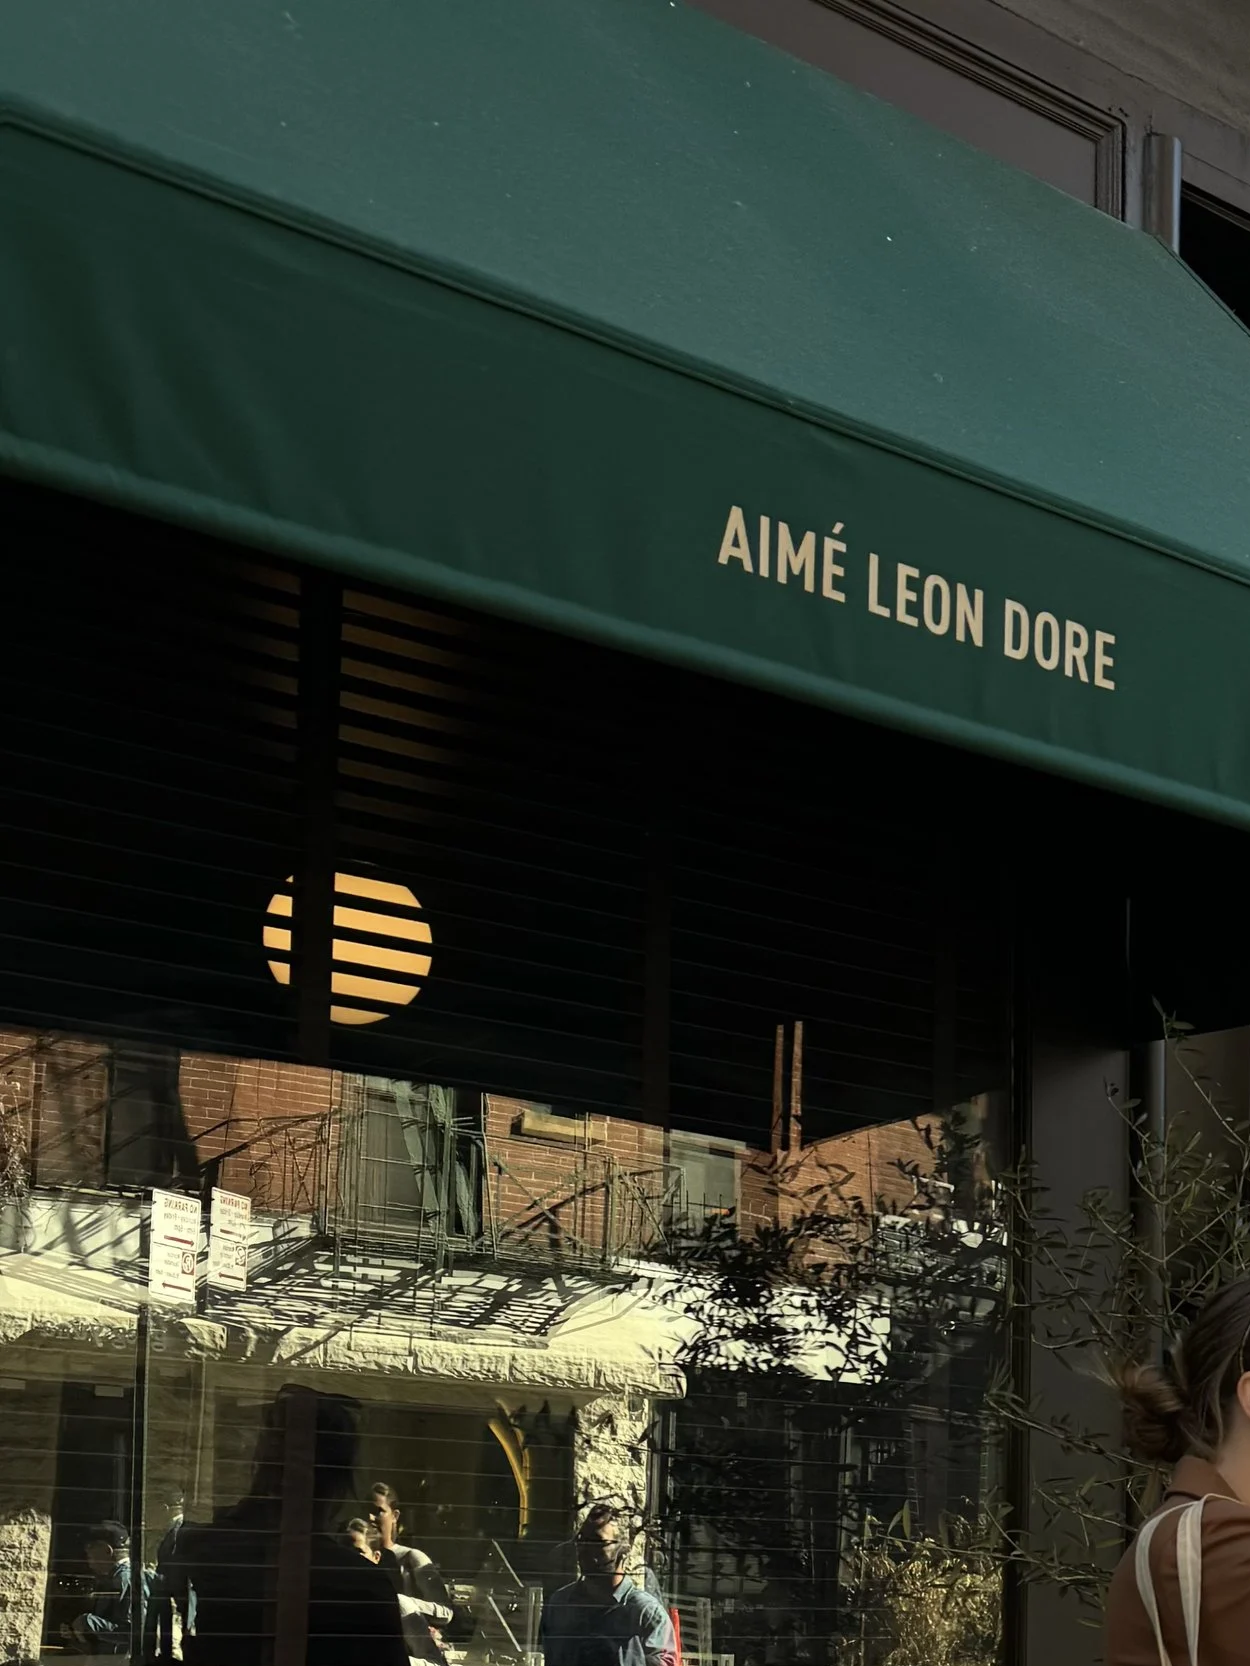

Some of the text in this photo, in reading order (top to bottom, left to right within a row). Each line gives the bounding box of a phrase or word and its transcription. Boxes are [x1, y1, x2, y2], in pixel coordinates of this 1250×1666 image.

[717, 505, 1116, 691] AIMÉ LEON DORE
